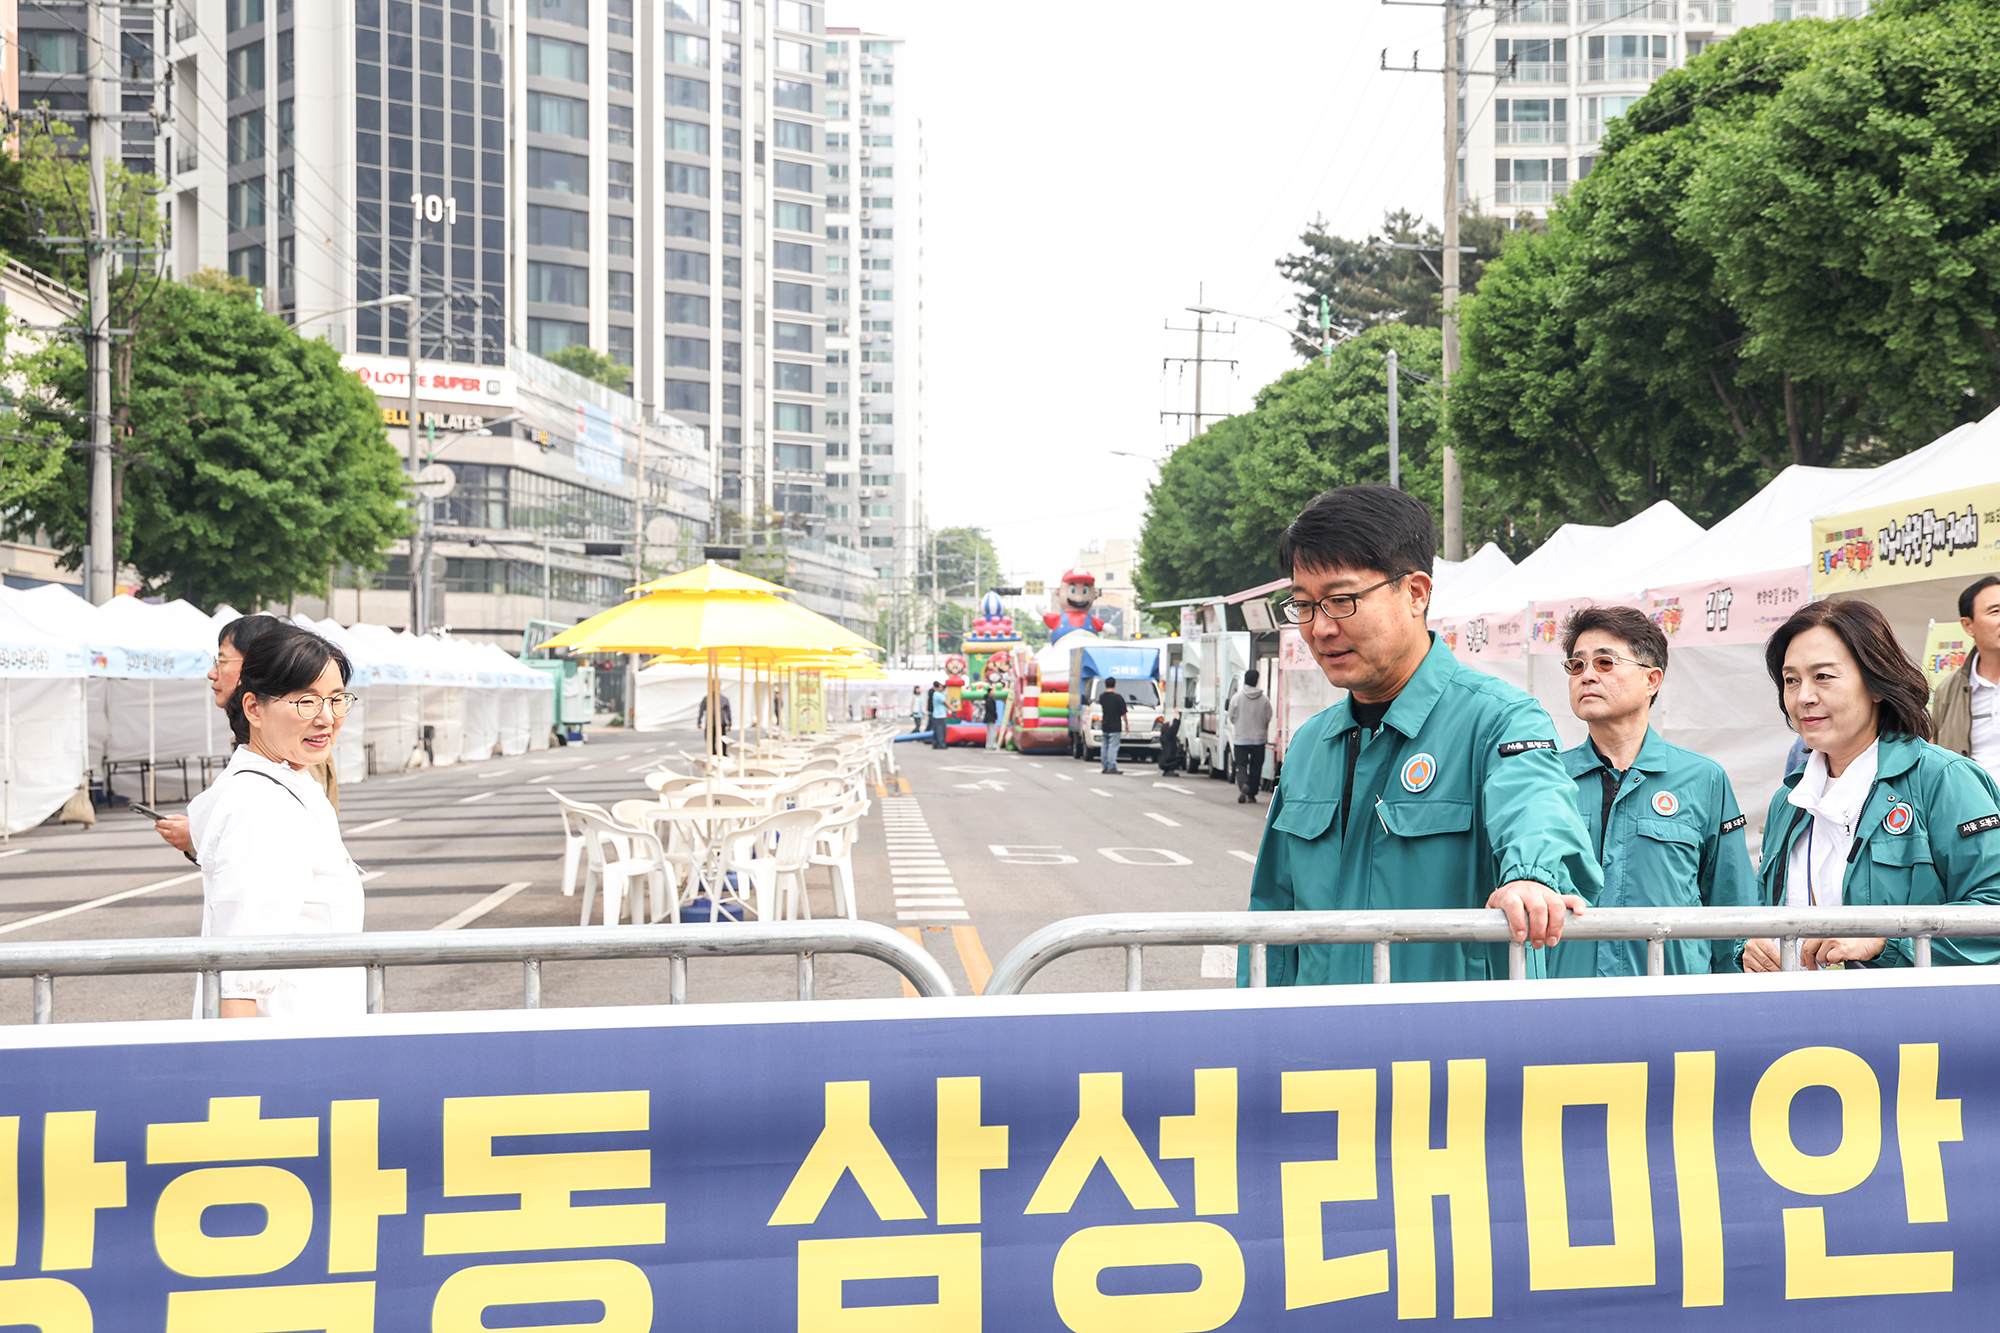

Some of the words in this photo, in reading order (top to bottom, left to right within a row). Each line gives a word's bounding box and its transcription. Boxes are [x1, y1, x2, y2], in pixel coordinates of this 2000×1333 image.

[411, 192, 457, 225] 101
[375, 371, 428, 388] LOTE
[433, 374, 481, 392] SUPER
[424, 411, 484, 430] PILATES
[1706, 587, 1733, 632] 김밥
[1507, 742, 1524, 750] 서울
[1526, 741, 1551, 749] 도봉구
[1963, 822, 1978, 832] 서울
[1979, 817, 1999, 827] 도봉구
[988, 844, 1195, 866] 50
[767, 1042, 1964, 1333] 삼성래미안
